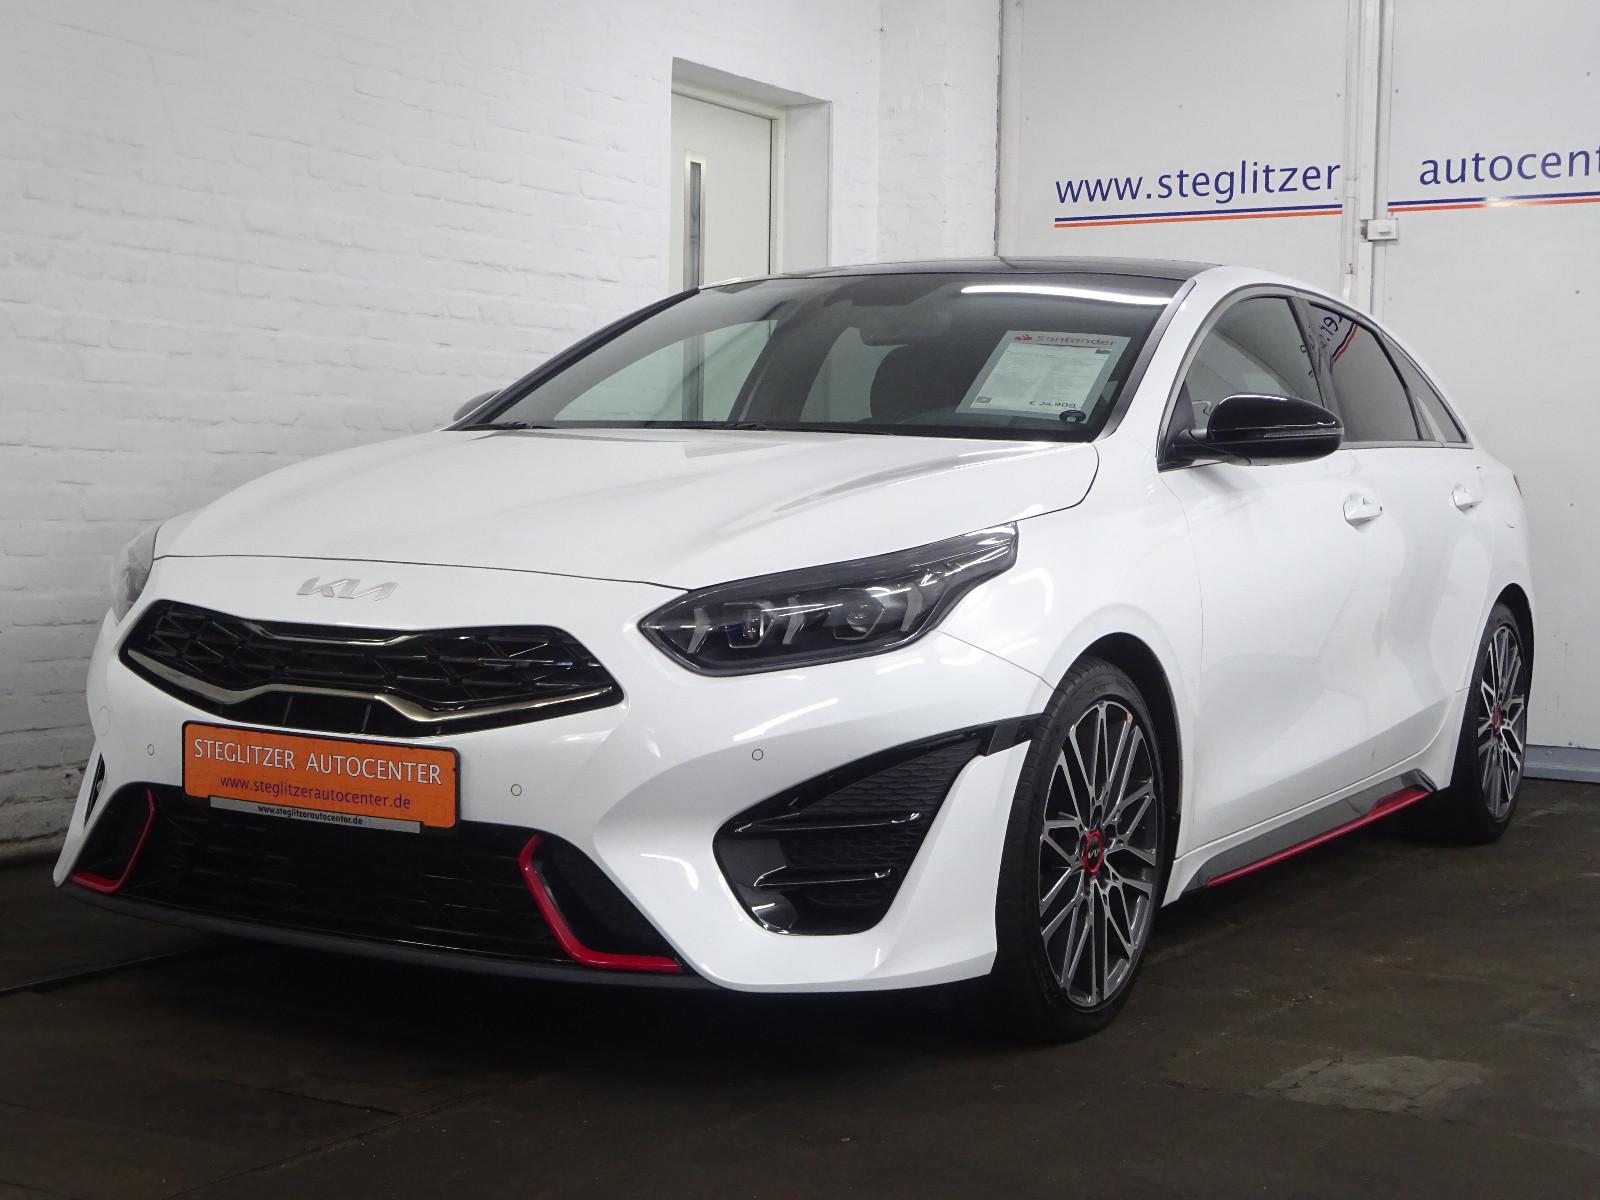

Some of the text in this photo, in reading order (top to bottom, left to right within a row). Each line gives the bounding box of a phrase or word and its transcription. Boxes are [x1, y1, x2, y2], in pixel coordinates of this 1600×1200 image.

[1055, 160, 1341, 205] www.steglitzer
[1036, 334, 1115, 347] Santander
[194, 738, 442, 786] STEGLITZER AUTOCENTER
[220, 775, 412, 810] www.steglitzerautocenter.de
[257, 803, 363, 826] www.steglitzerautocenter.de
